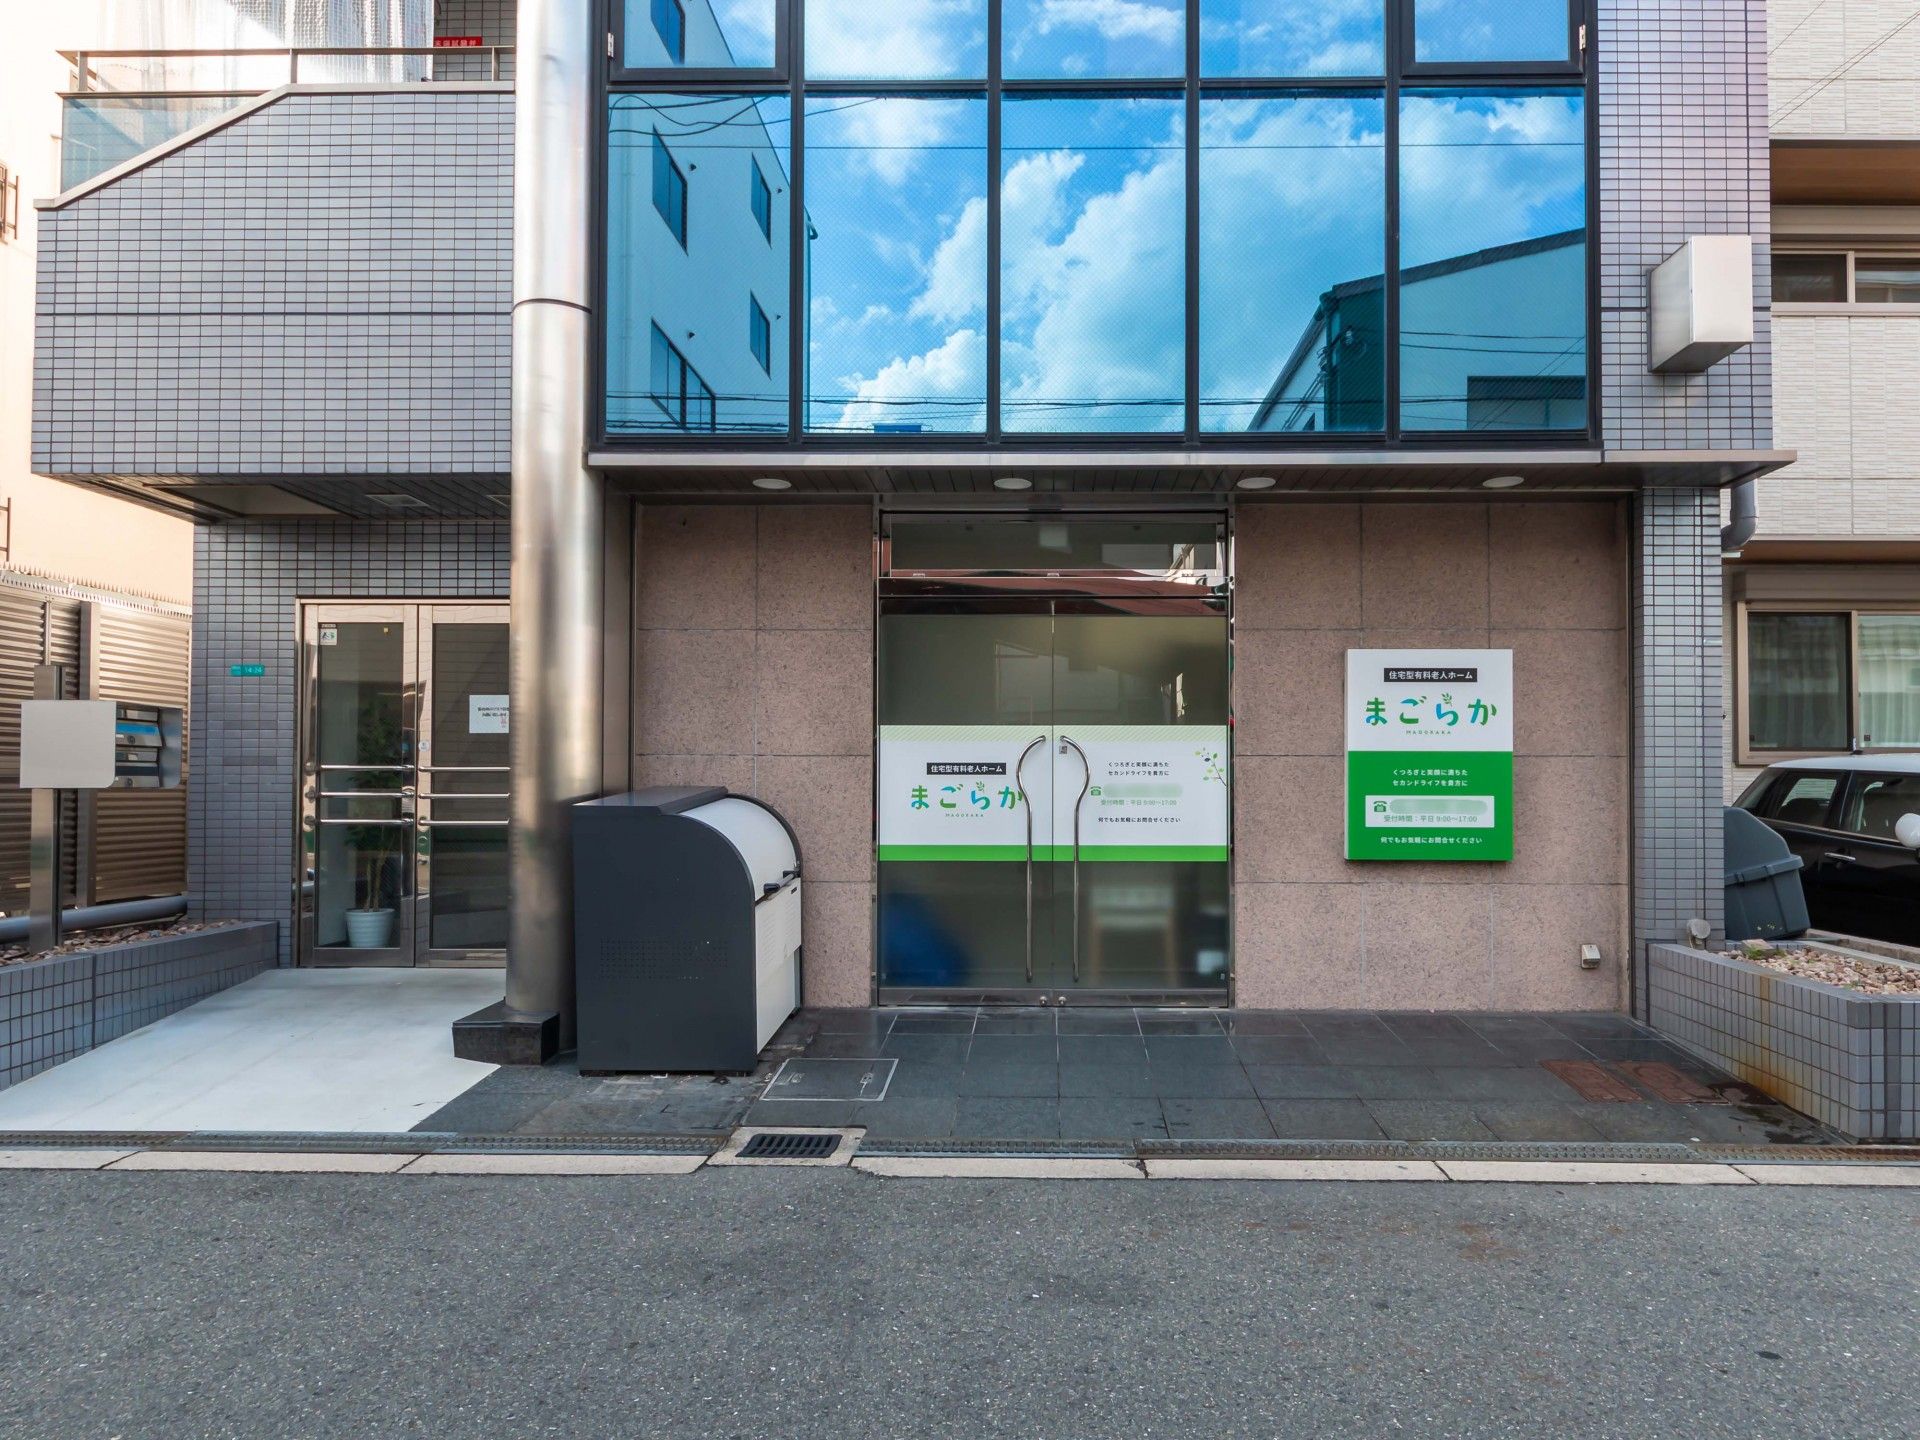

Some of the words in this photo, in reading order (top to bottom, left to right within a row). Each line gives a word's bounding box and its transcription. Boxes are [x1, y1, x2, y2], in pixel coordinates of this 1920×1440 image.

[1388, 670, 1474, 680] 住宅型有料老人ホーム
[1366, 692, 1497, 727] まごらか
[930, 764, 1003, 773] 住宅型有料老人ホーム
[1392, 768, 1469, 777] くつろぎと笑顔に満ちた
[1392, 779, 1469, 787] セカンドライフを貴方に
[910, 781, 1024, 811] まごらか
[1380, 836, 1483, 845] 何でもお気軽にお問合せください
